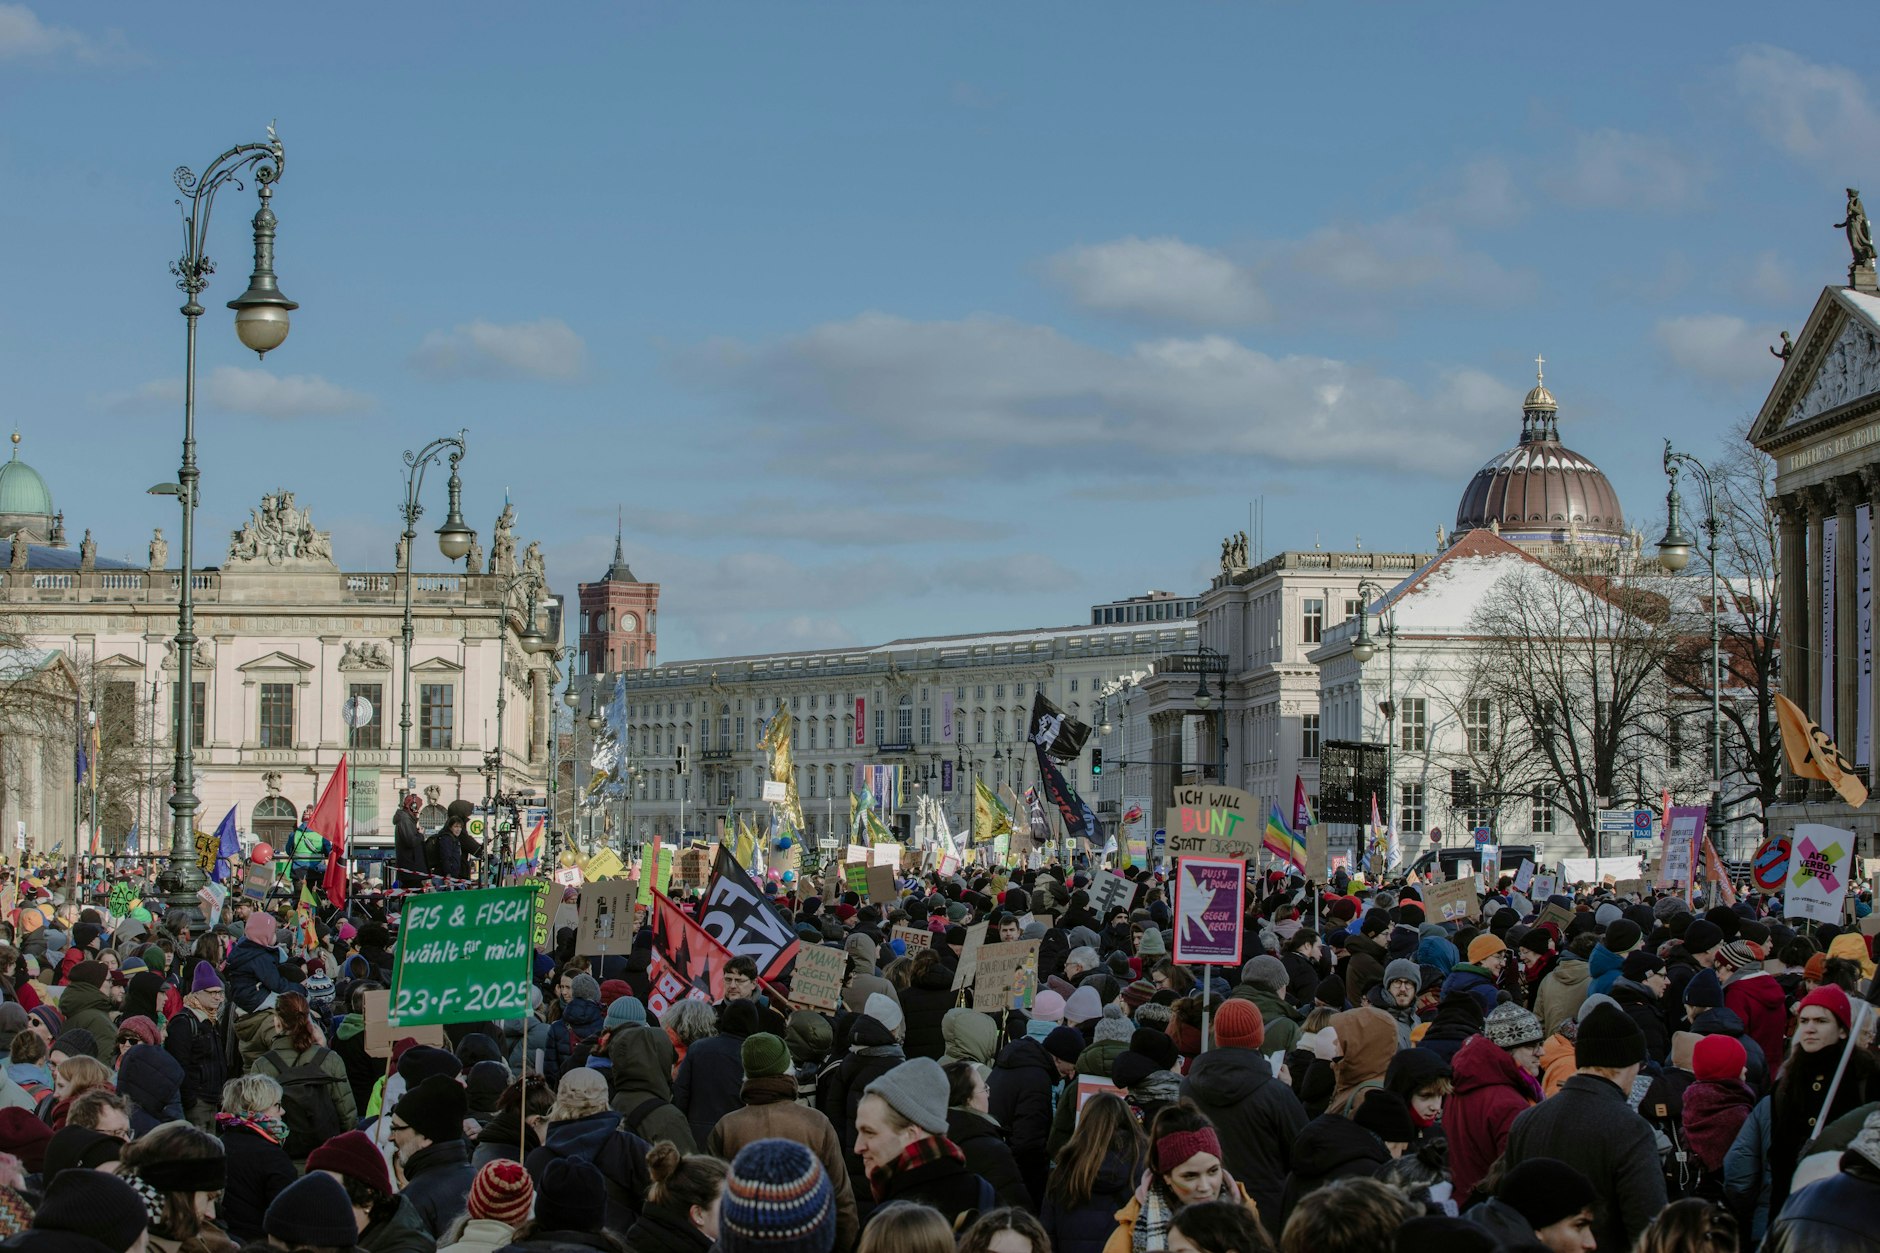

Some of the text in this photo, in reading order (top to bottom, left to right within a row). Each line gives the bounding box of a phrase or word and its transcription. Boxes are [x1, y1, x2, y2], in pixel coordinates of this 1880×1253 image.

[1835, 436, 1850, 454] REX
[1180, 790, 1239, 809] ICH WILL
[1181, 807, 1245, 837] BUNT
[1169, 835, 1206, 851] STATT
[1808, 852, 1829, 862] AFD
[1201, 869, 1228, 878] PUSSY
[1799, 860, 1837, 872] VERBOT
[1802, 869, 1832, 880] JETZT
[110, 885, 138, 901] FACK
[1210, 880, 1237, 890] POWER
[408, 899, 530, 930] EIS & FISCH
[1203, 912, 1230, 921] GEGEN
[1208, 922, 1236, 932] RECHTS
[404, 936, 526, 963] wählt für mich
[805, 950, 841, 971] MAMA
[798, 966, 835, 983] GEGEN
[796, 980, 838, 1000] RECHTS
